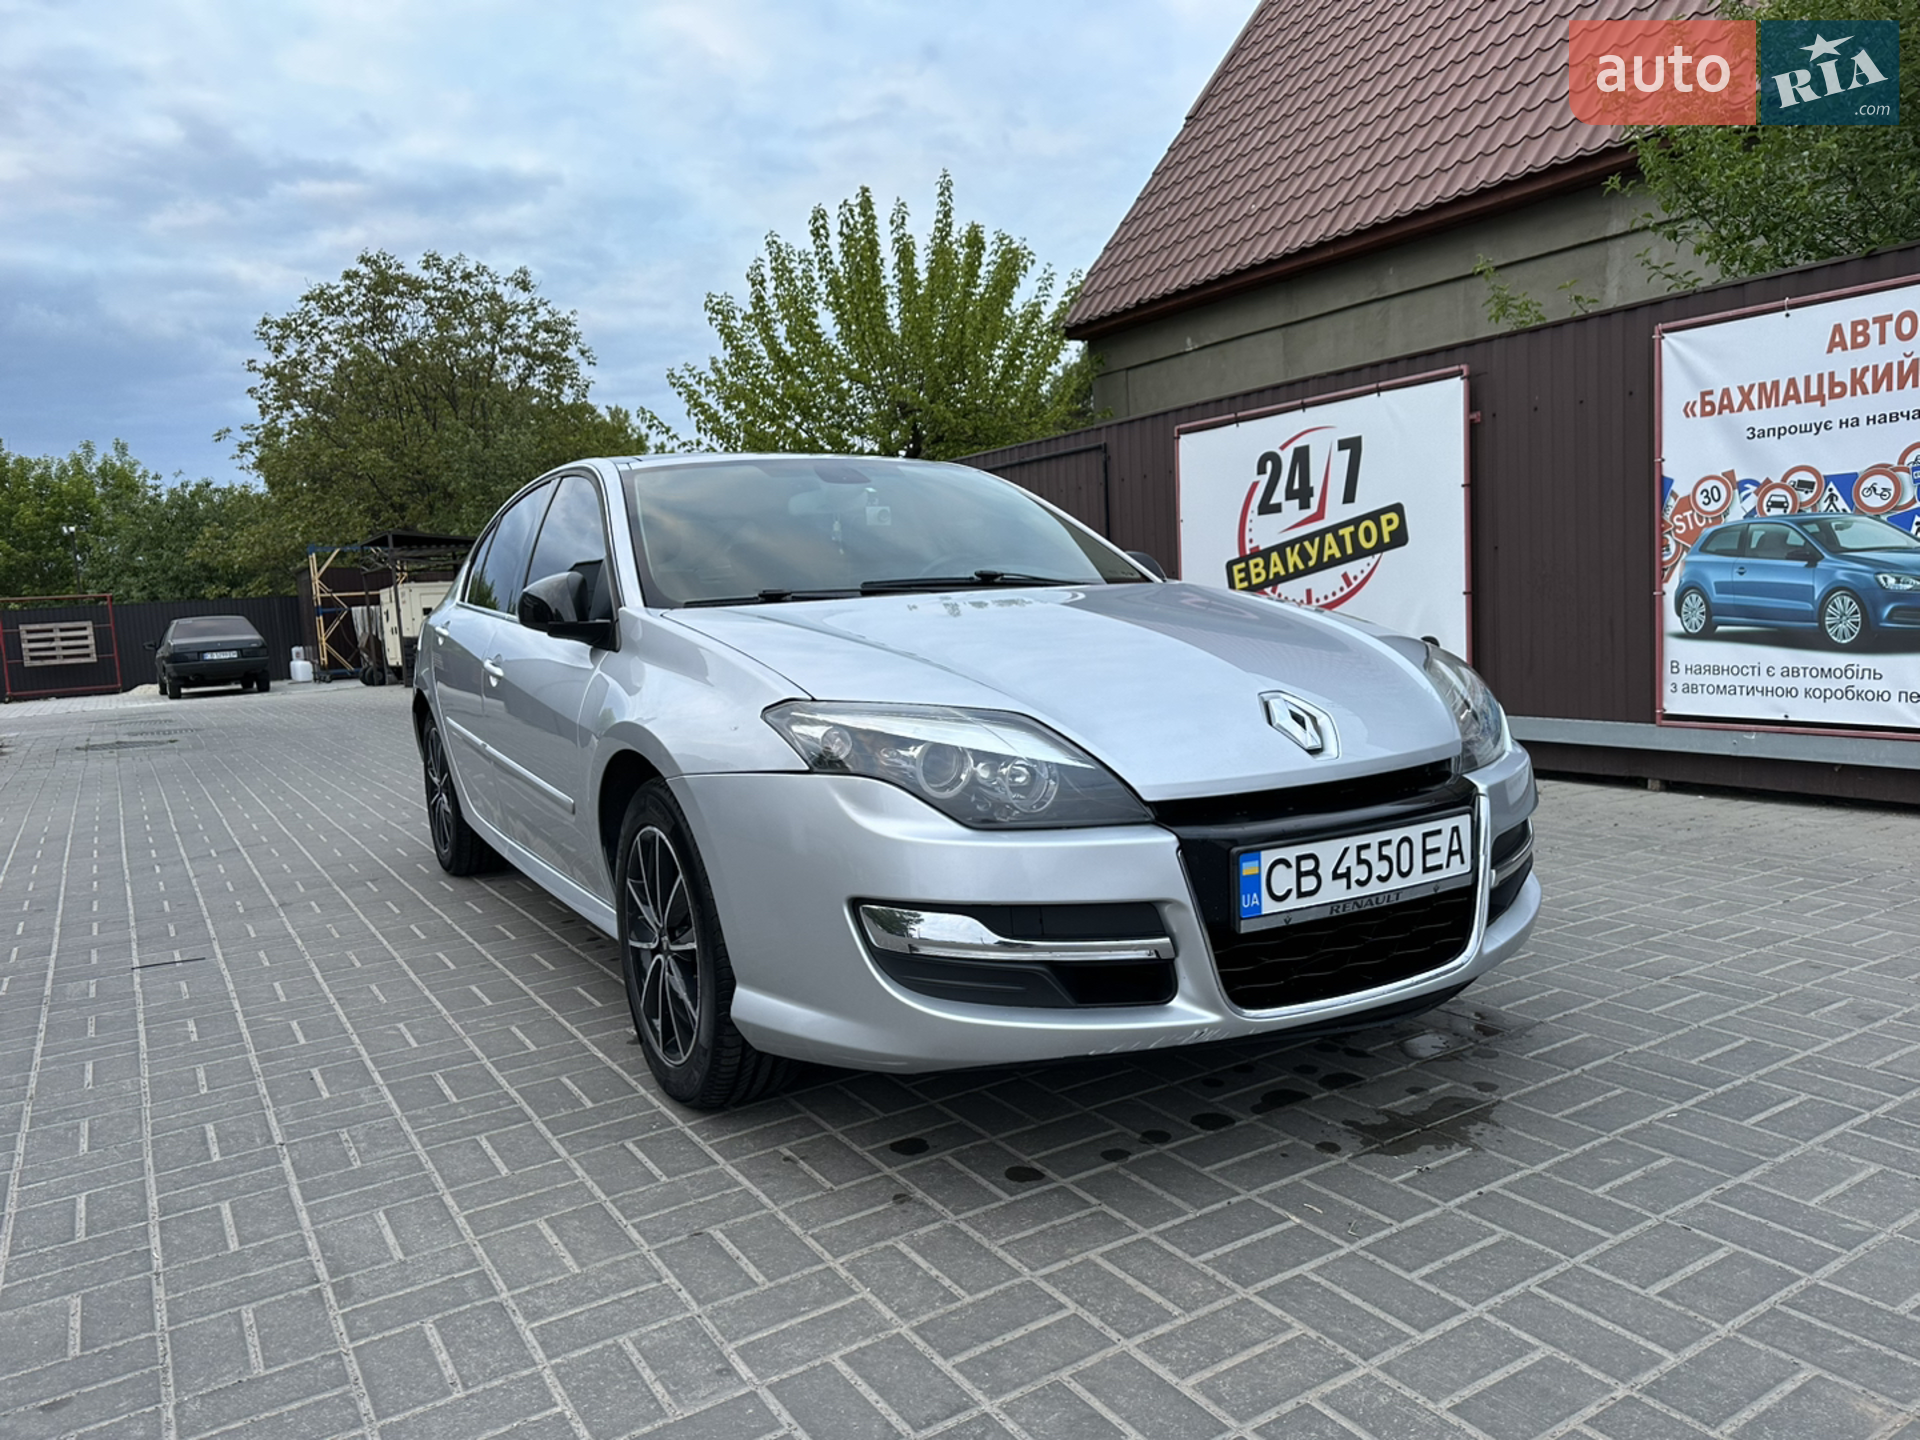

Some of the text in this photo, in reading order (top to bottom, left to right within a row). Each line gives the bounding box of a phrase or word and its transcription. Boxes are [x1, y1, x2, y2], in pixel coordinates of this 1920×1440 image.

[1746, 419, 1833, 440] Запрошує
[1838, 415, 1860, 429] на
[1700, 485, 1722, 506] 30
[1673, 509, 1713, 534] STO
[1232, 511, 1400, 591] ЕВАКУАТОР
[1669, 660, 1883, 681] В наявності є автомобіль
[1669, 682, 1678, 693] з
[1681, 682, 1799, 698] автоматичною
[1803, 685, 1892, 704] коробкою
[1265, 825, 1466, 902] CB 4550 EA
[1242, 893, 1260, 908] UA
[1328, 891, 1404, 916] RENAULT
